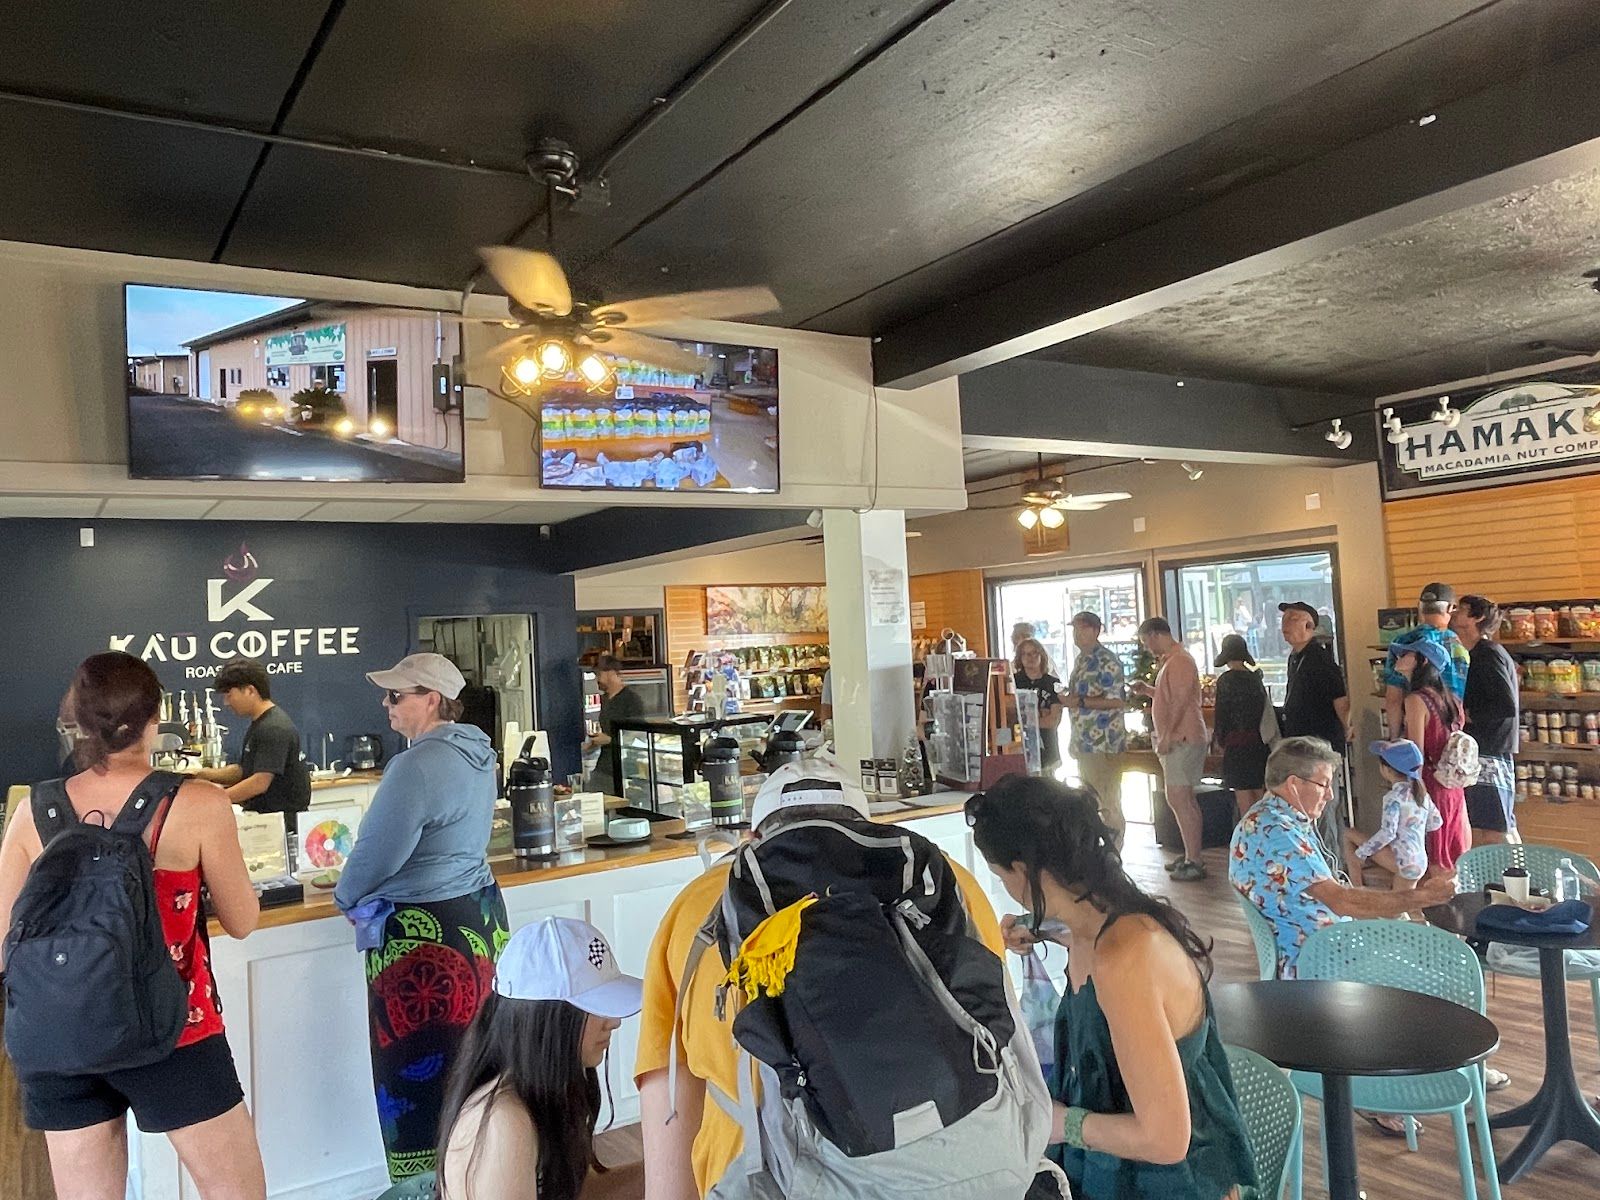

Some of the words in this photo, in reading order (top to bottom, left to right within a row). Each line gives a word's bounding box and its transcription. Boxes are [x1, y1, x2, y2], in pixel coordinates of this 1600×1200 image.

[1425, 453, 1511, 473] MACADAMIA
[1517, 447, 1548, 460] NUT
[1553, 440, 1600, 454] COMP
[207, 578, 275, 622] K
[210, 627, 360, 660] COFFEE
[266, 661, 303, 674] CAFE
